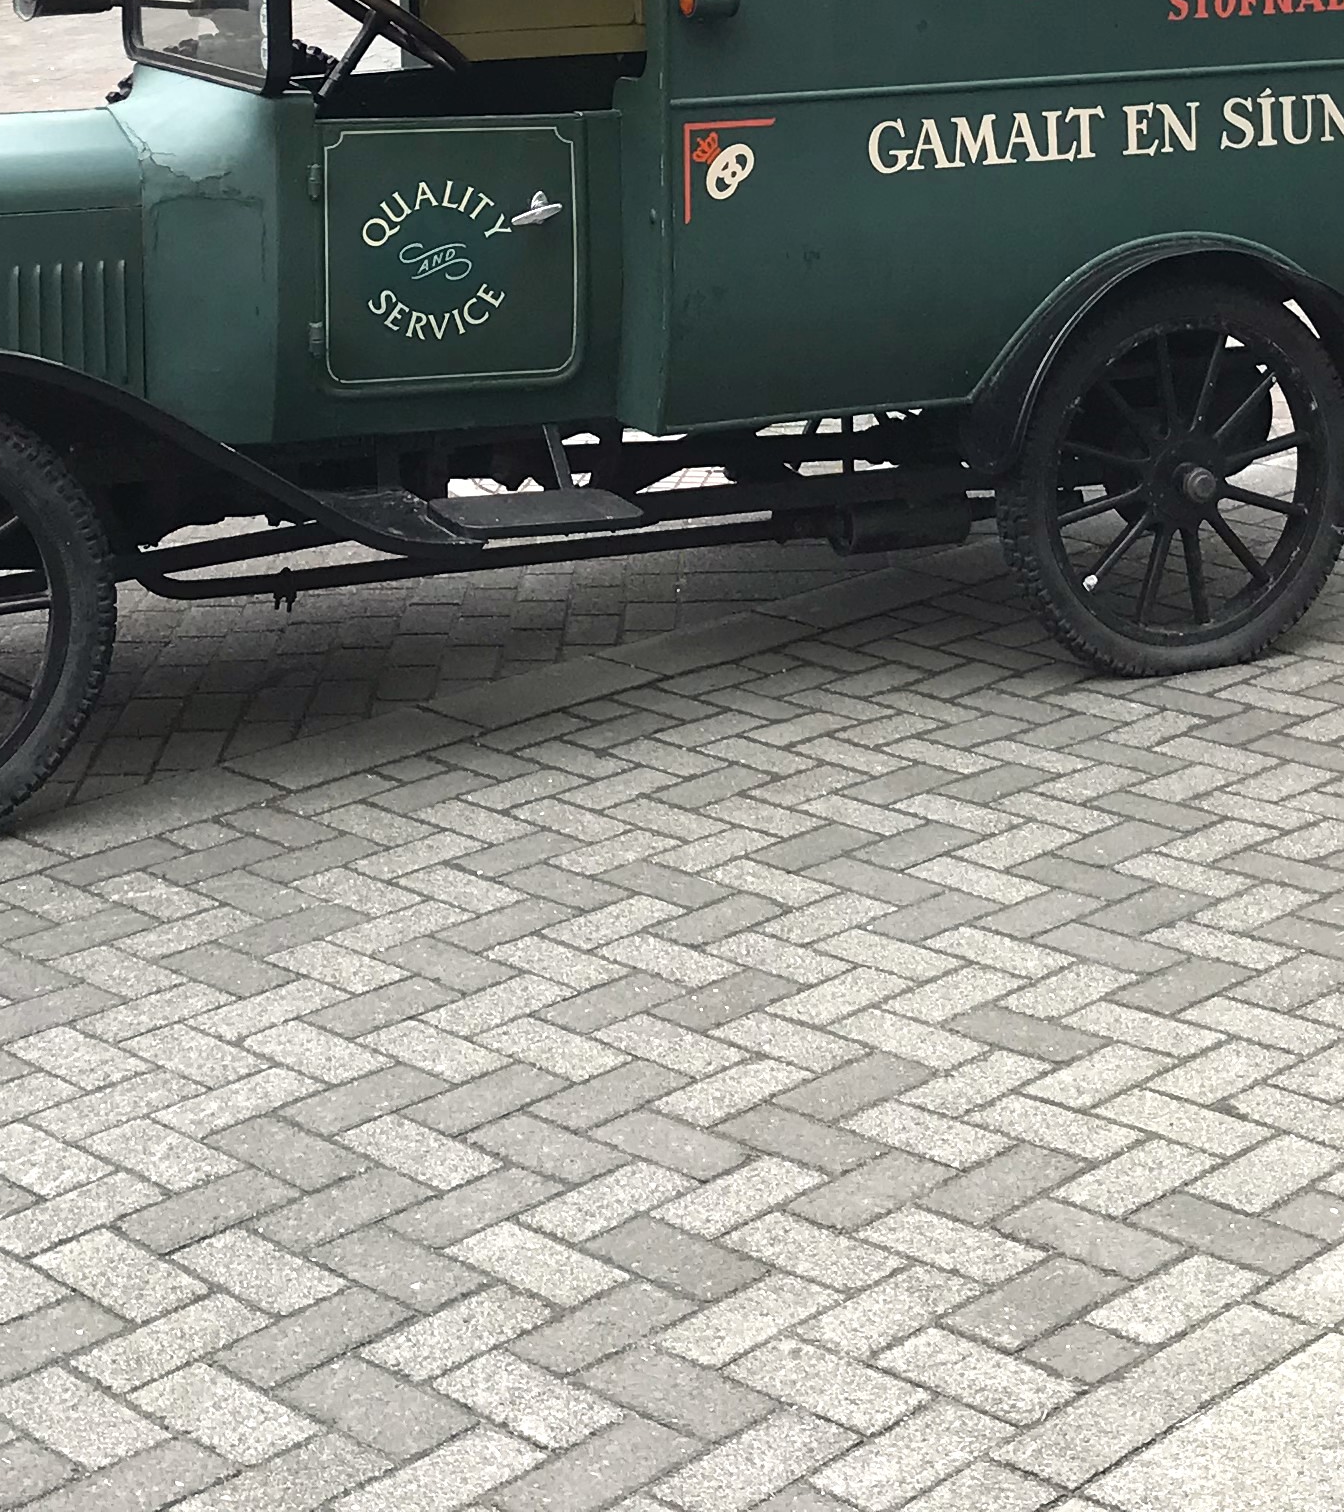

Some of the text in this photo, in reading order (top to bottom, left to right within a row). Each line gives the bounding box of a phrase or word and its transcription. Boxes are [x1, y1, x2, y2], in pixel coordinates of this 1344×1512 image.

[867, 105, 1105, 175] GAMALT
[1122, 101, 1200, 157] EN
[362, 179, 513, 248] QUALITY
[417, 248, 457, 274] AND
[367, 283, 506, 341] SERVICE
